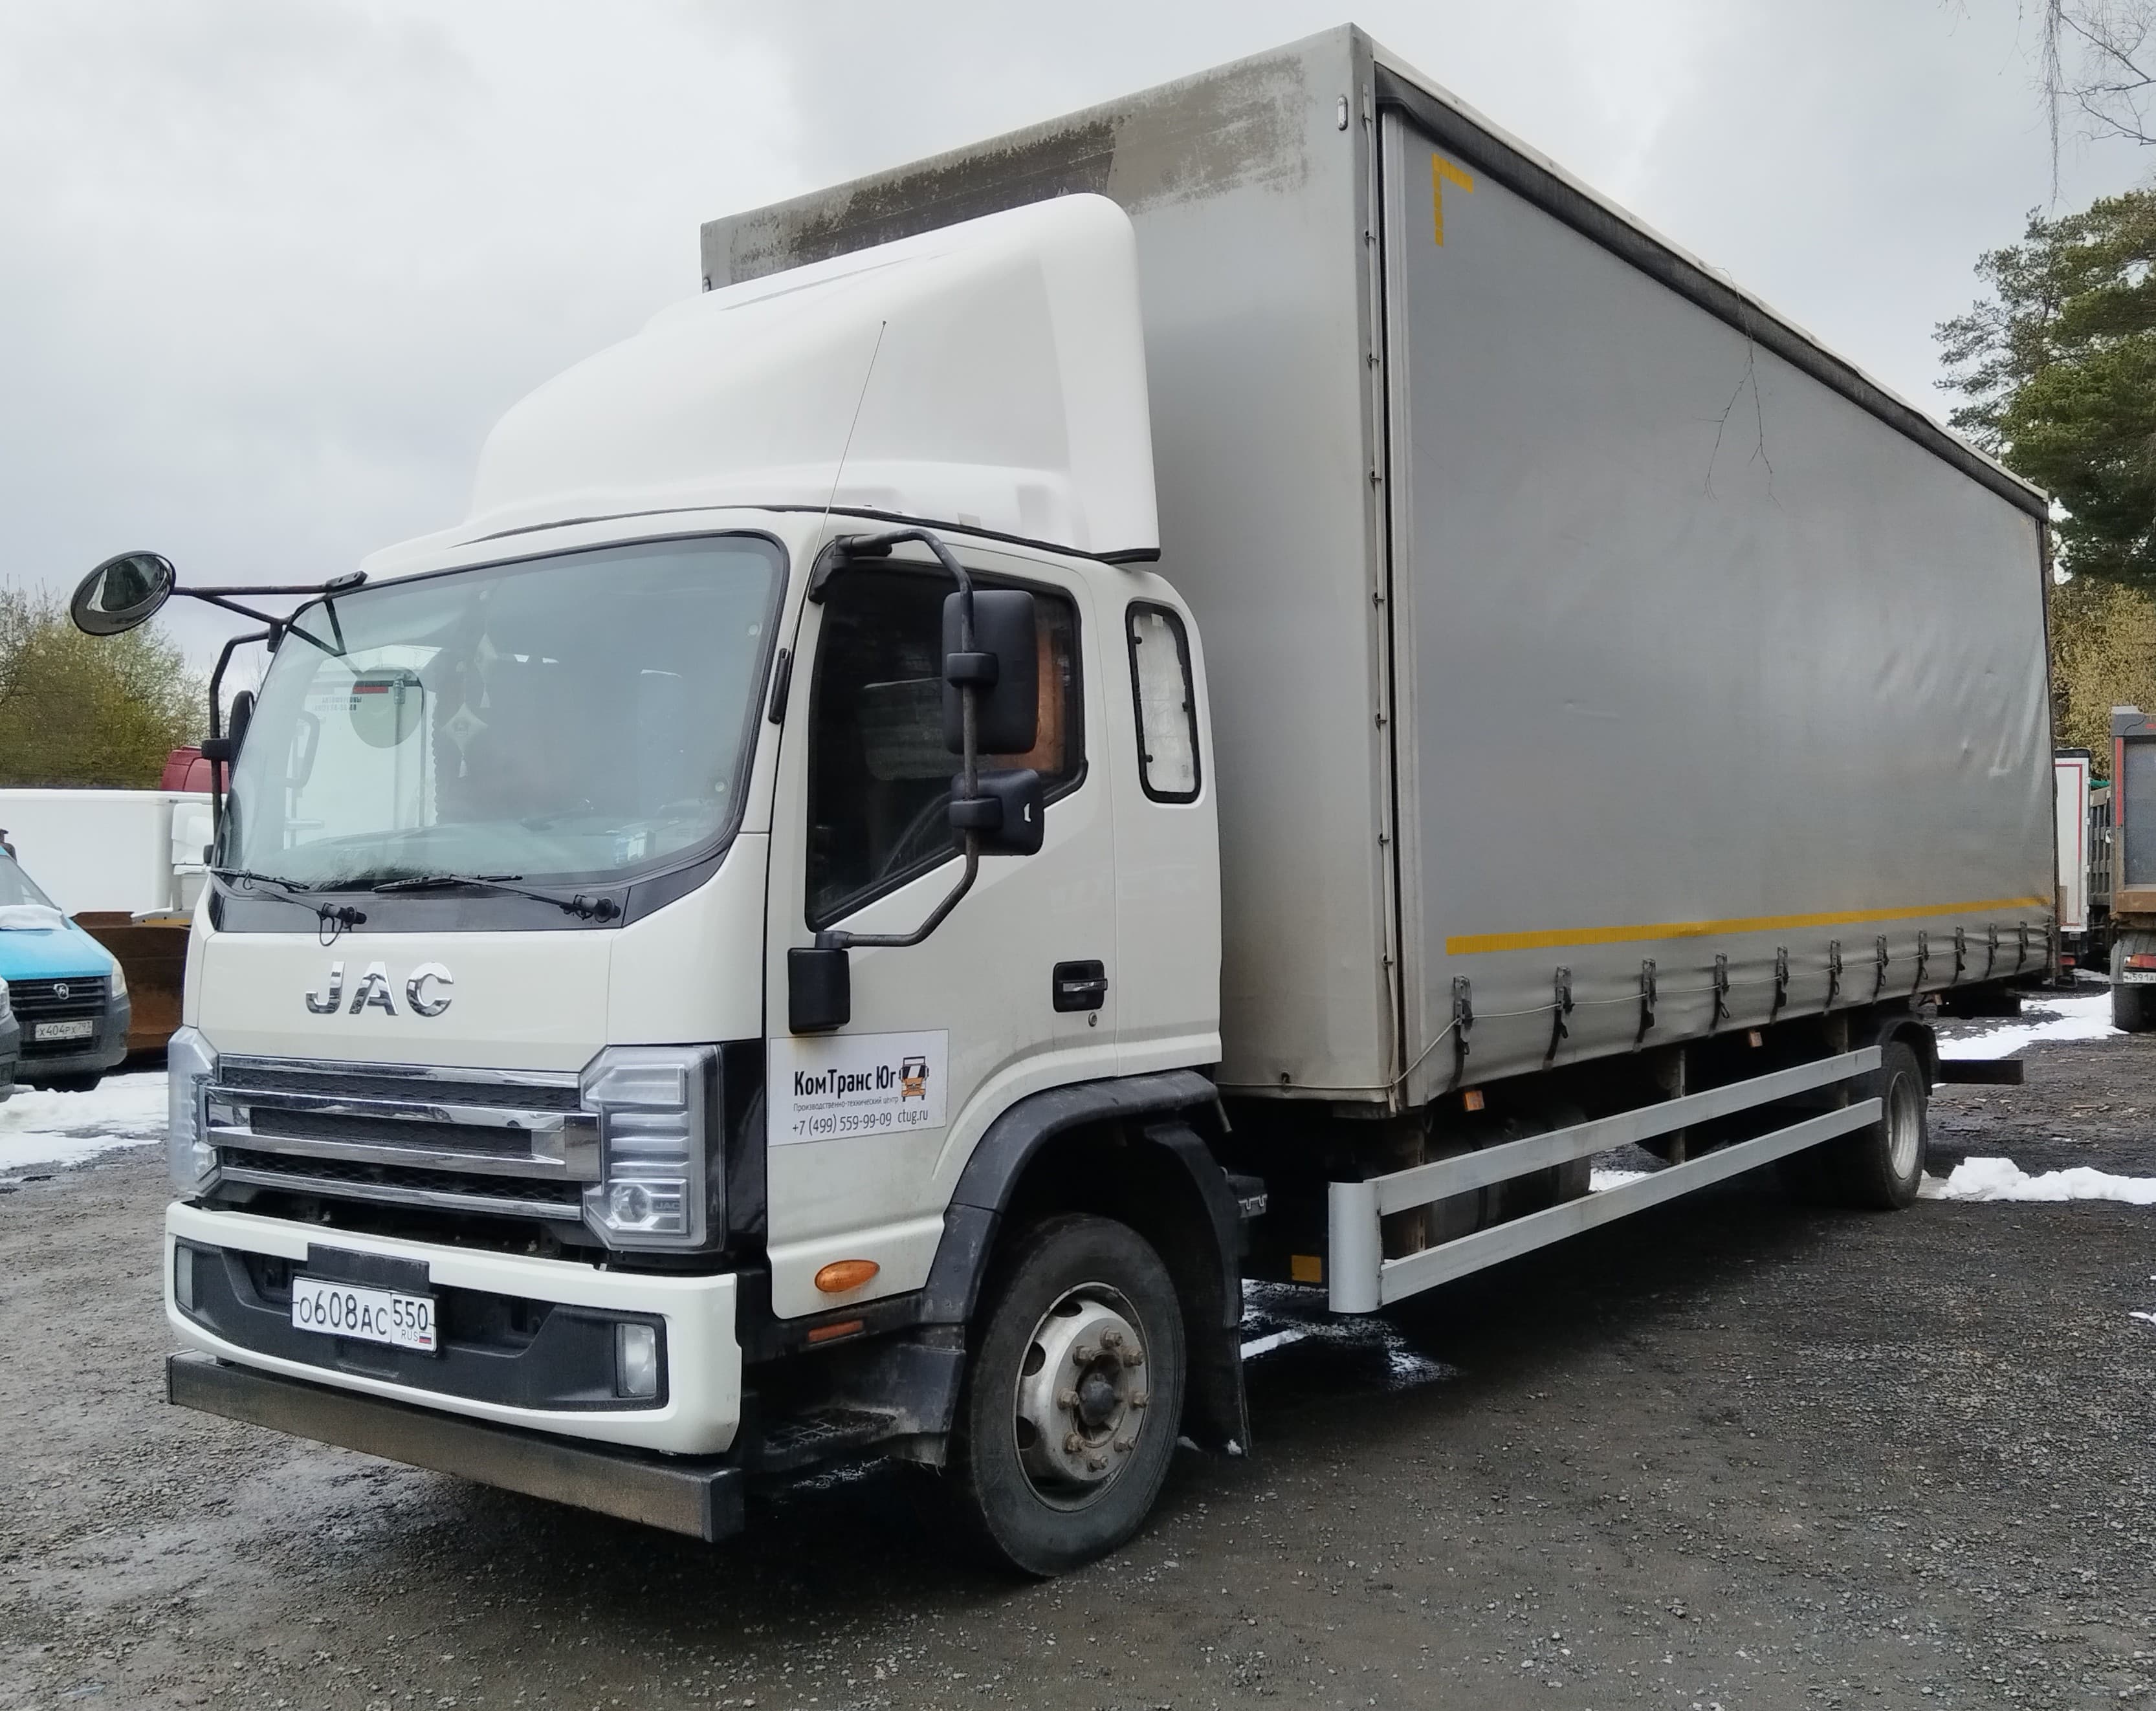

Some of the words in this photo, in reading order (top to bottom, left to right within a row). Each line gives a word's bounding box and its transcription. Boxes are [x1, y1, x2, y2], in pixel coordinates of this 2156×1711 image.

[305, 961, 454, 1018] JAC
[794, 1069, 872, 1098] КомТранс
[876, 1065, 896, 1089] Юг
[883, 1096, 899, 1105] центр
[793, 1120, 806, 1135] +7
[808, 1114, 837, 1136] (499)
[839, 1112, 892, 1131] 559-99-09
[897, 1109, 929, 1125] ctug.ru
[393, 1298, 428, 1331] 550
[401, 1329, 419, 1342] RUS
